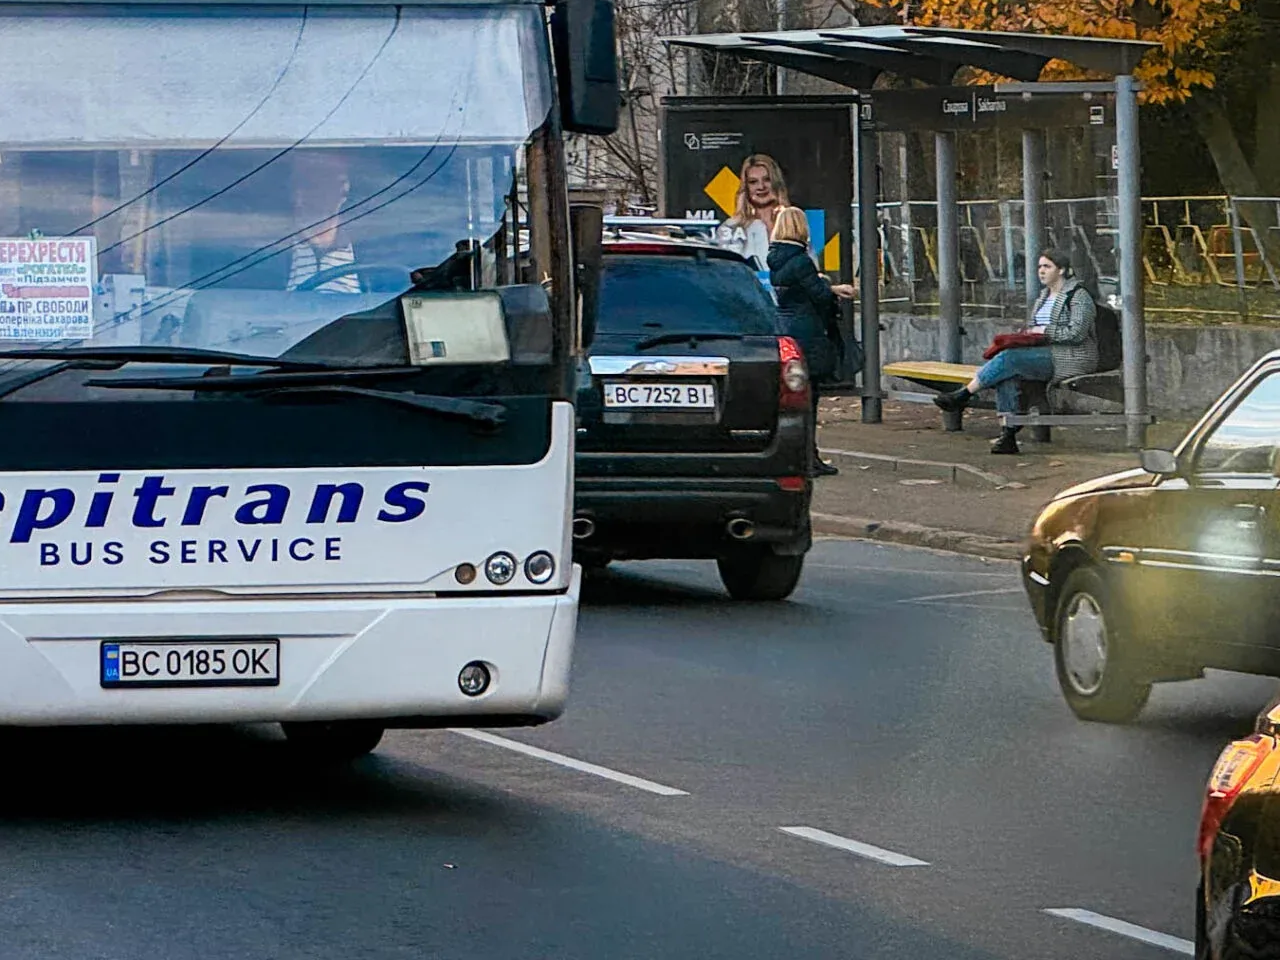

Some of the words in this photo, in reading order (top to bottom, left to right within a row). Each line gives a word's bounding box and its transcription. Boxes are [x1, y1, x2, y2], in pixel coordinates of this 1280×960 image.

[44, 314, 88, 326] Сахарова
[645, 387, 682, 404] 7252
[40, 541, 125, 566] BUS
[148, 537, 342, 564] SERVICE
[122, 650, 160, 677] BC
[166, 649, 226, 676] 0185
[232, 648, 270, 675] OK
